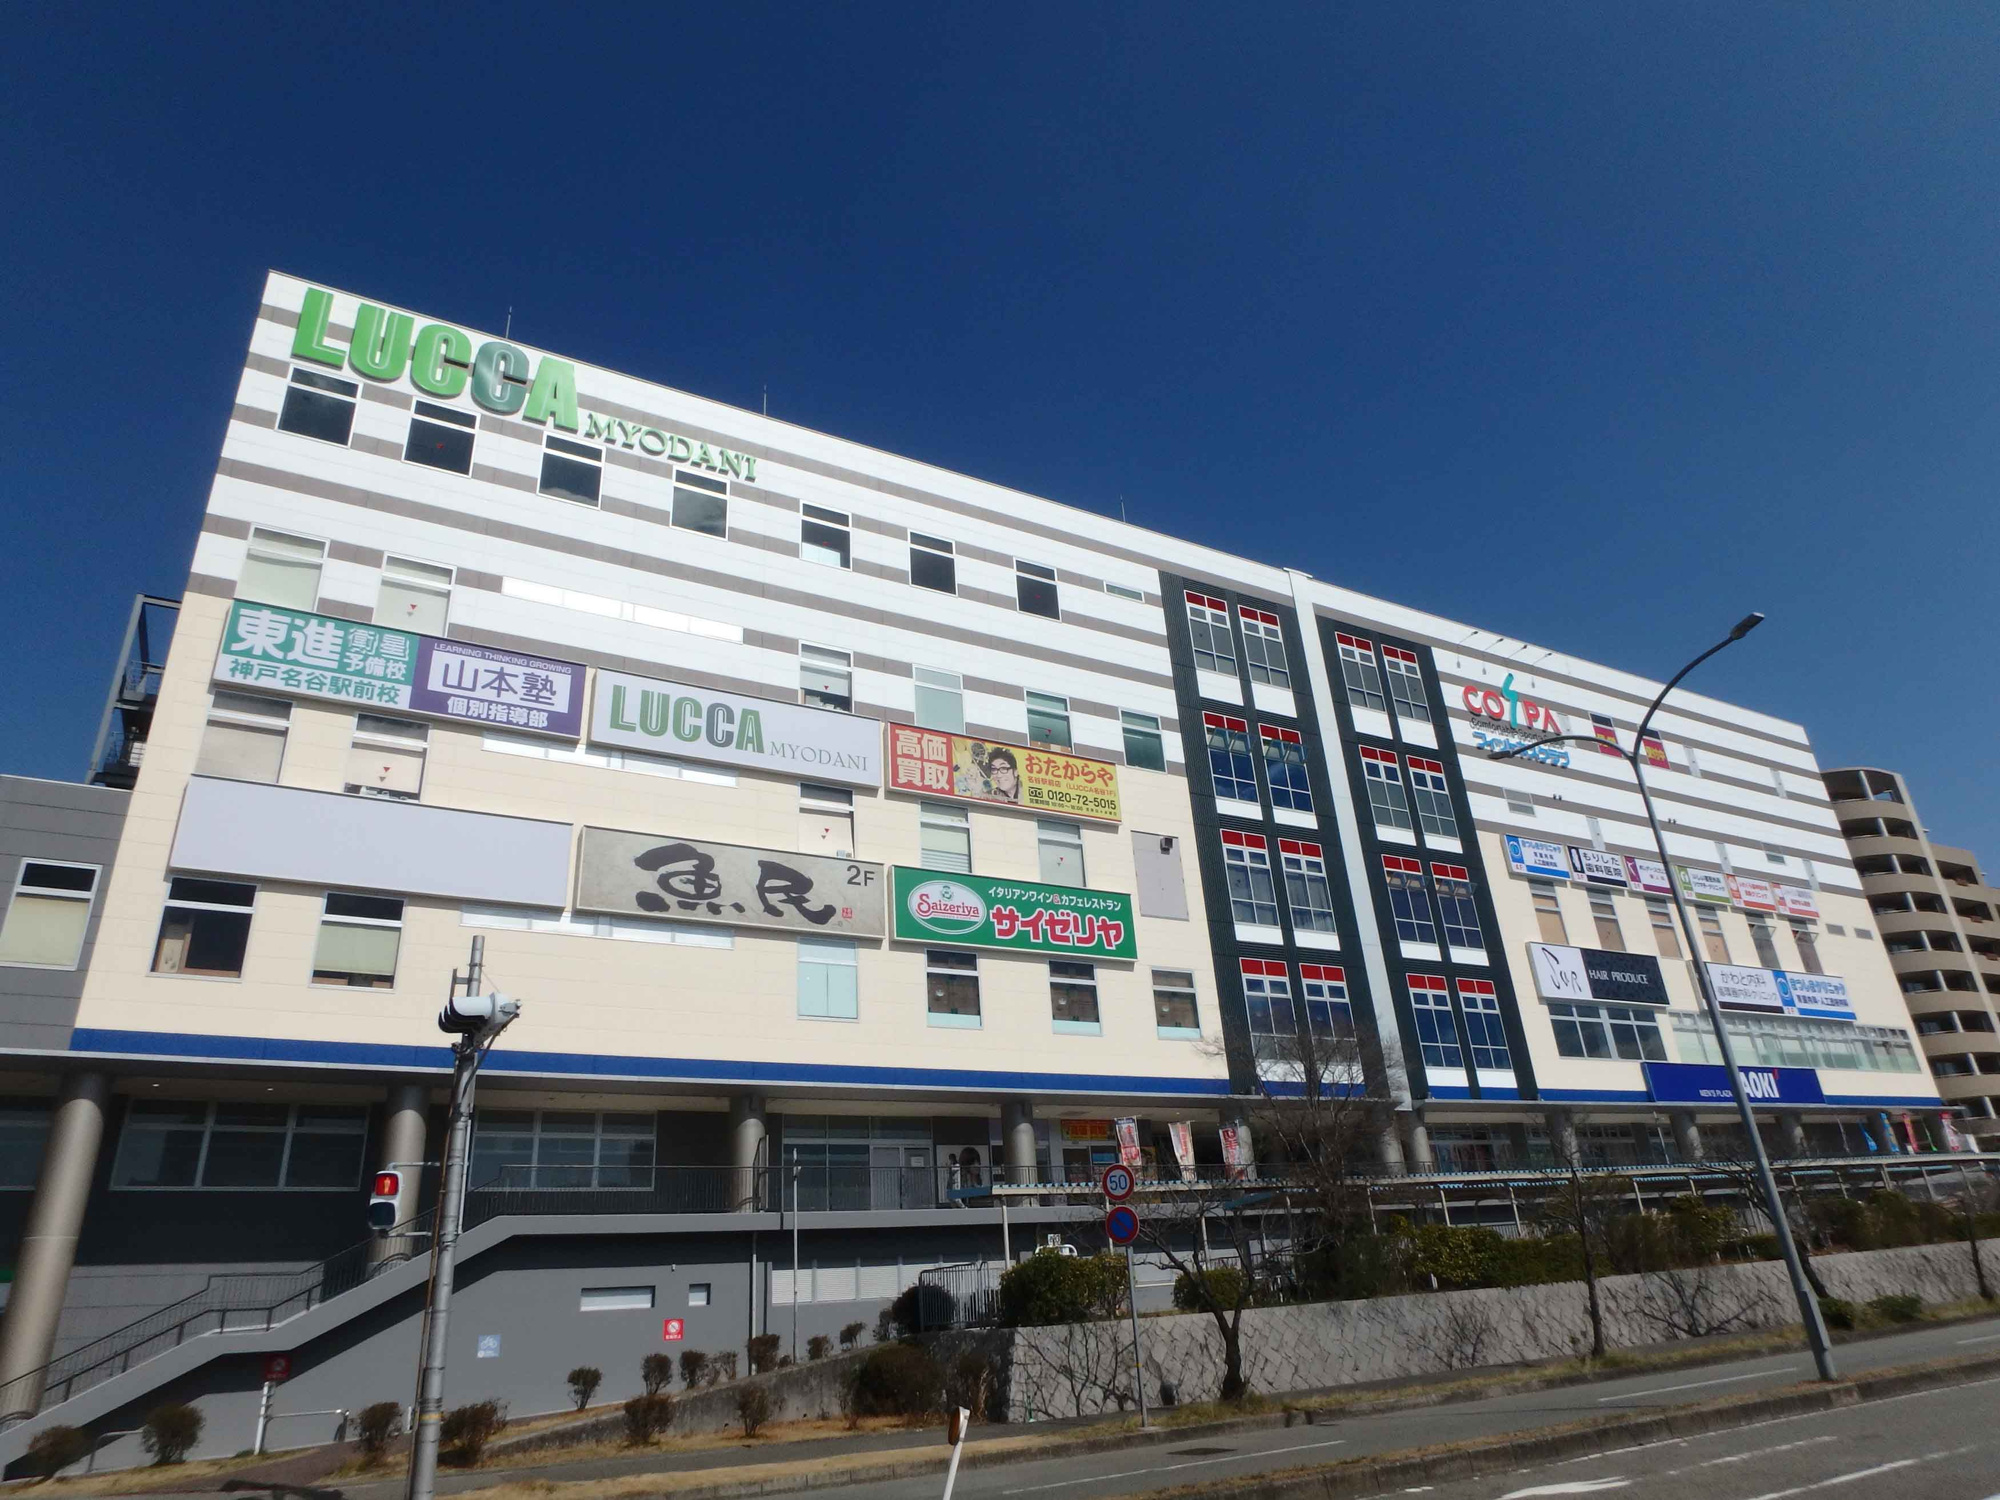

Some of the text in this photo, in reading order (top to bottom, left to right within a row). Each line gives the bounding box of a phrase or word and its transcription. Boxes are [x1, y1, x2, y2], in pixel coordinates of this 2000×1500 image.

[291, 287, 759, 482] LUCCA MYODANI
[230, 607, 344, 670] 東進
[348, 627, 410, 661] 衛星
[343, 651, 407, 681] 予備校
[434, 642, 572, 674] LEARNING THINKING GROWING
[229, 657, 401, 706] 神戸名谷駅前校
[441, 658, 557, 707] 山本塾
[447, 696, 549, 730] 個別指導部
[1462, 672, 1562, 735] COSPA
[609, 684, 869, 772] LUCCA MYODANI
[895, 728, 948, 763] 高価
[896, 757, 950, 791] 買取
[1024, 753, 1114, 787] おたからや
[1047, 789, 1117, 810] 0120-72-5015
[1582, 851, 1620, 866] もりした
[1585, 862, 1623, 878] 歯科医院
[634, 842, 876, 925] 魚民 2F
[988, 886, 1122, 912] イタリアンワイン&カフェレストラン
[916, 893, 980, 918] Saizeriya
[990, 904, 1124, 950] サイゼリヤ
[1589, 969, 1649, 985] HAIR PRODUCE
[1739, 1071, 1780, 1099] AOKI
[1109, 1174, 1128, 1191] 50
